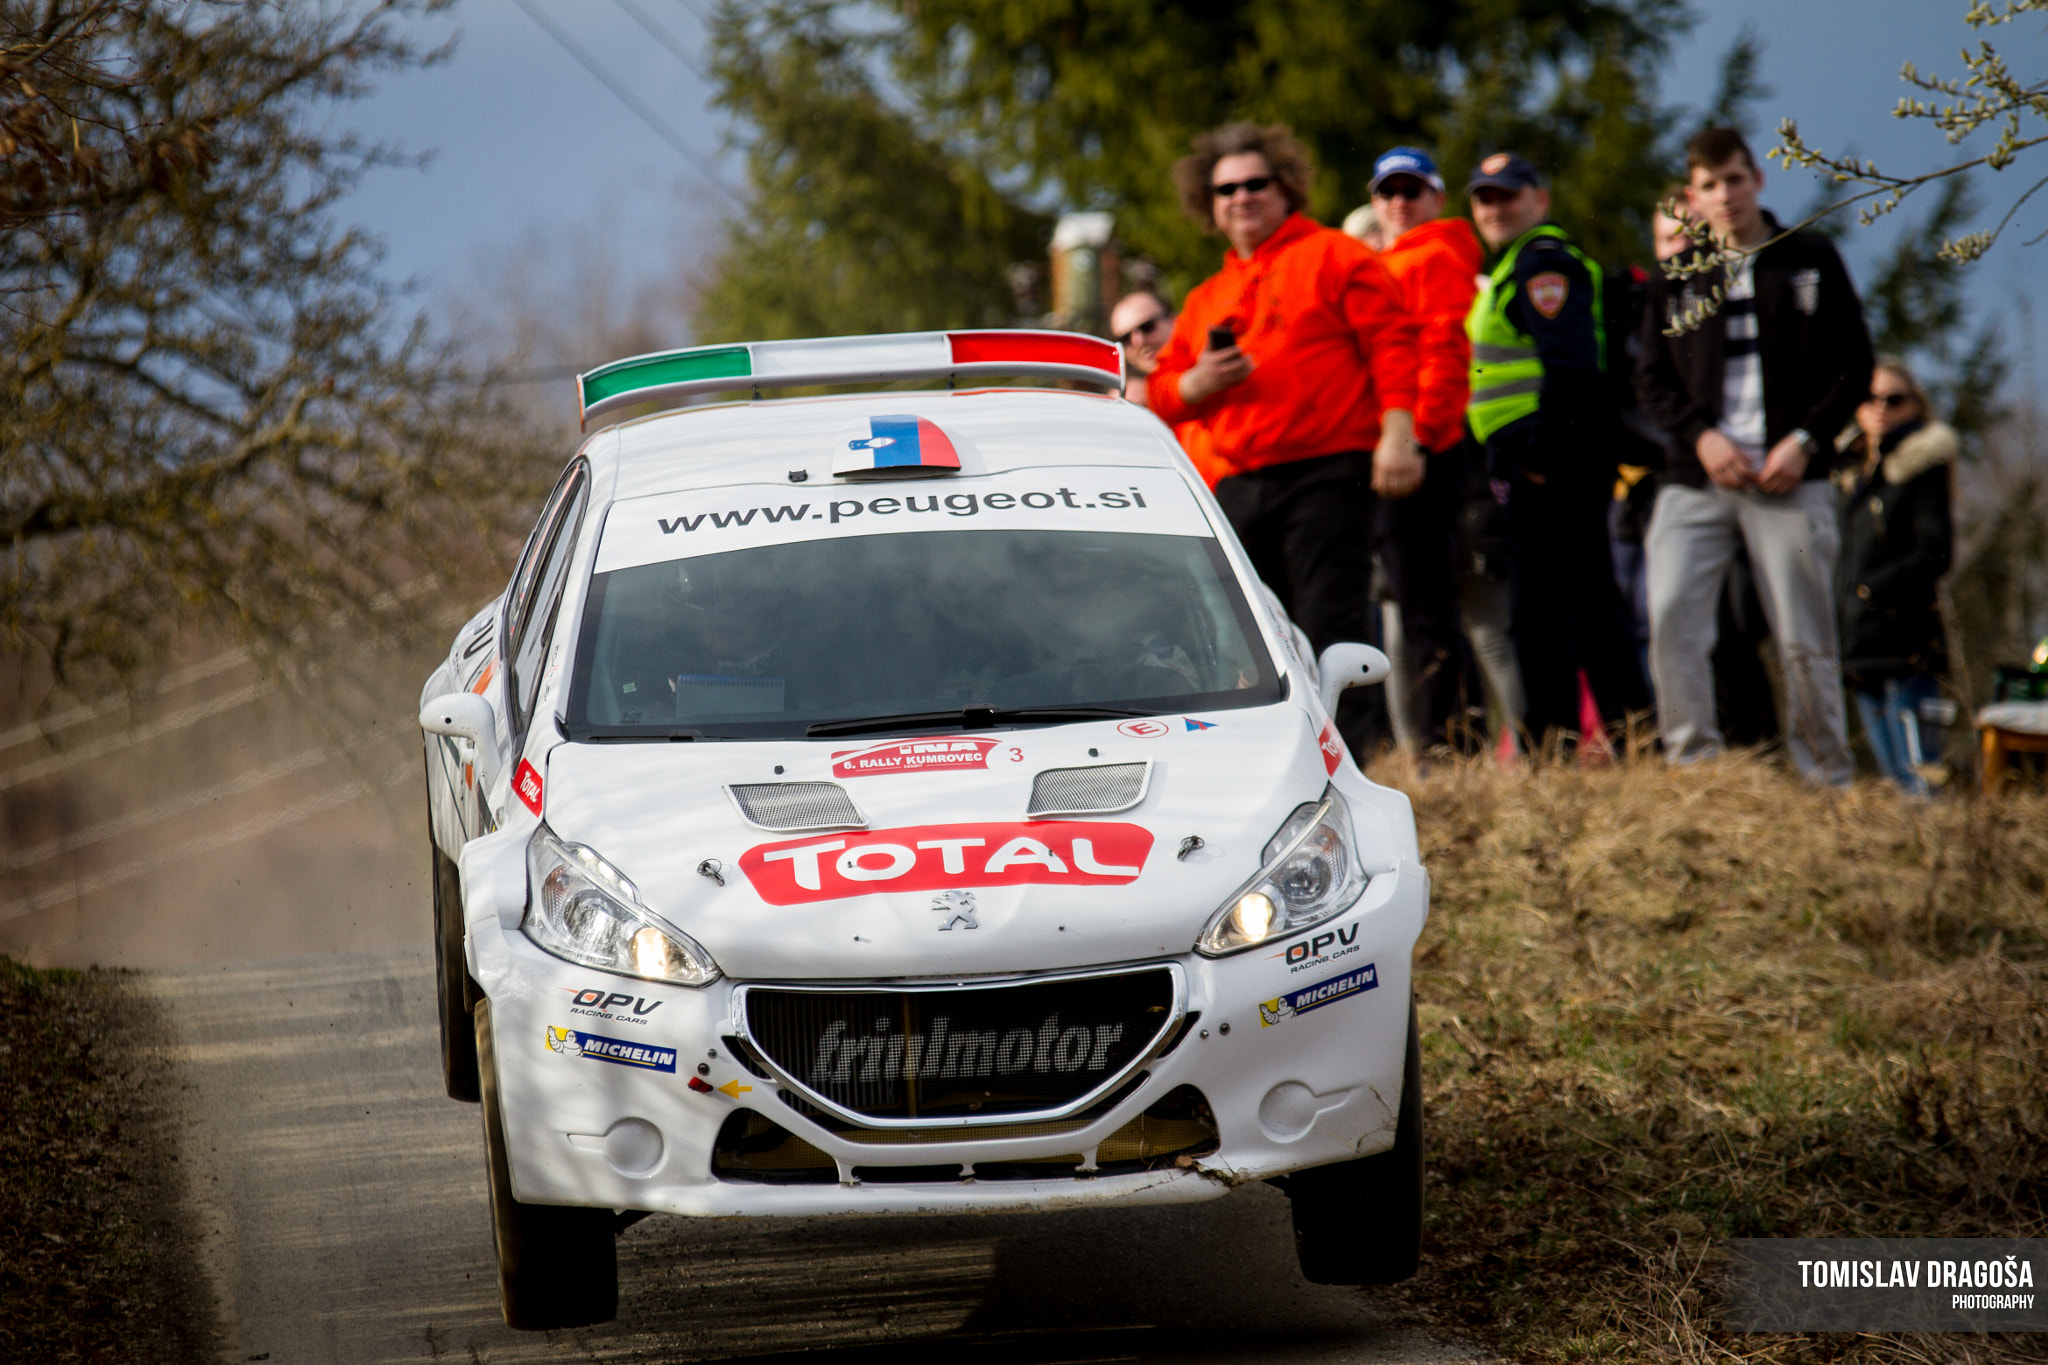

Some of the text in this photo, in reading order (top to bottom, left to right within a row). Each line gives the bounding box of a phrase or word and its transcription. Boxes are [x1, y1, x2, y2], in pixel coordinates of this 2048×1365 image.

[657, 486, 1148, 535] www.peugeot.si
[843, 760, 856, 770] 6.
[860, 757, 902, 769] RALLY
[906, 752, 983, 765] KUMROVEC
[1009, 747, 1024, 762] 3
[520, 771, 540, 803] TOTAL
[763, 836, 1140, 891] TOTAL
[1286, 922, 1359, 965] OPV
[1290, 945, 1360, 974] RACING CARS
[572, 988, 663, 1015] OPV
[1296, 969, 1374, 1008] MICHELIN
[570, 1007, 648, 1025] RACING CARS
[584, 1039, 674, 1065] MICHELIN
